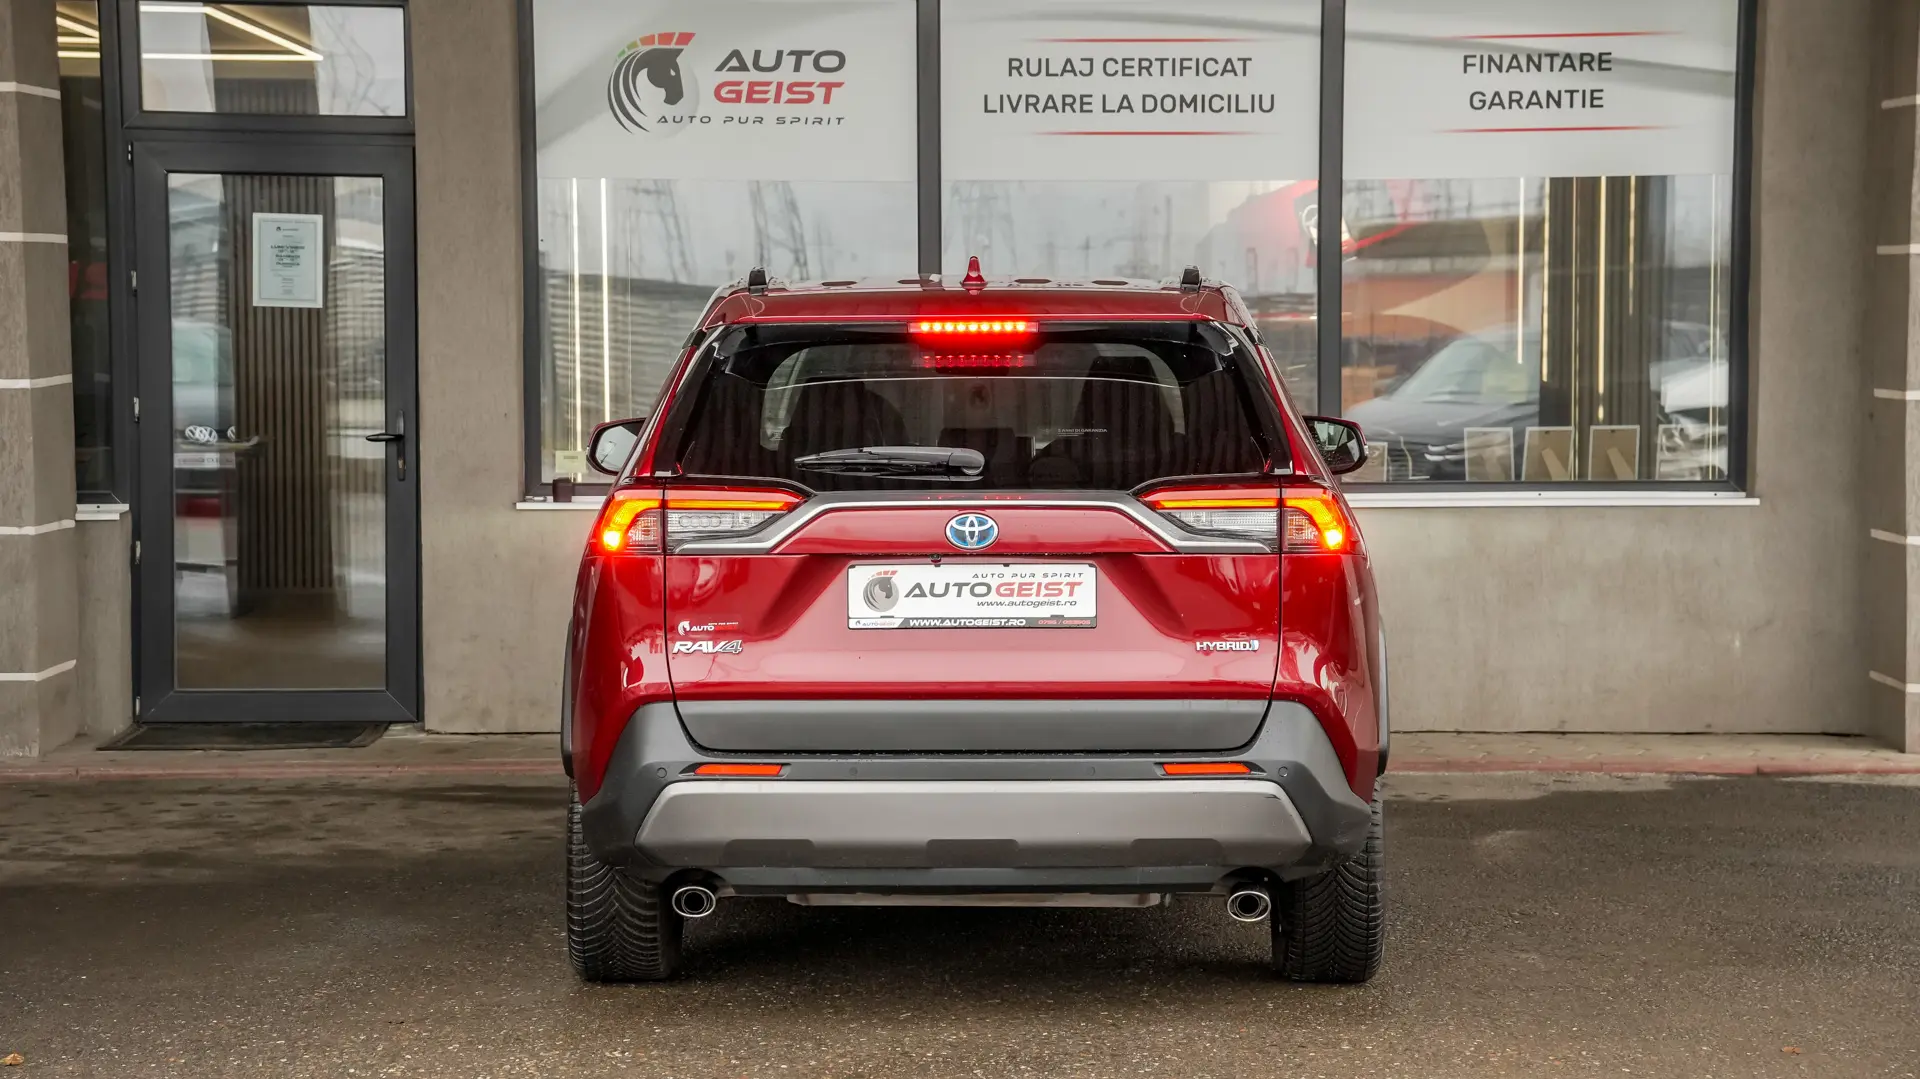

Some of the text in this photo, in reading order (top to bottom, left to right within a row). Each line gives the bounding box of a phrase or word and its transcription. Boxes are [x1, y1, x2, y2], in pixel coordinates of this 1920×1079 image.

[714, 48, 846, 73] AUTO
[1007, 57, 1253, 77] RULAJ CERTIFICAT
[1462, 51, 1613, 74] FINANTARE
[713, 80, 845, 105] GEIST
[1469, 88, 1605, 111] GARANTIE
[983, 94, 1275, 114] LIVRARE LA DOMICILIU
[656, 115, 845, 126] AUTO PUR SPIRIT
[976, 599, 1077, 609] www.autogeist.ro
[909, 618, 1027, 627] WWW.AUTOGEIST.RO
[672, 639, 743, 654] RAV4
[1195, 641, 1251, 651] HYBRID
